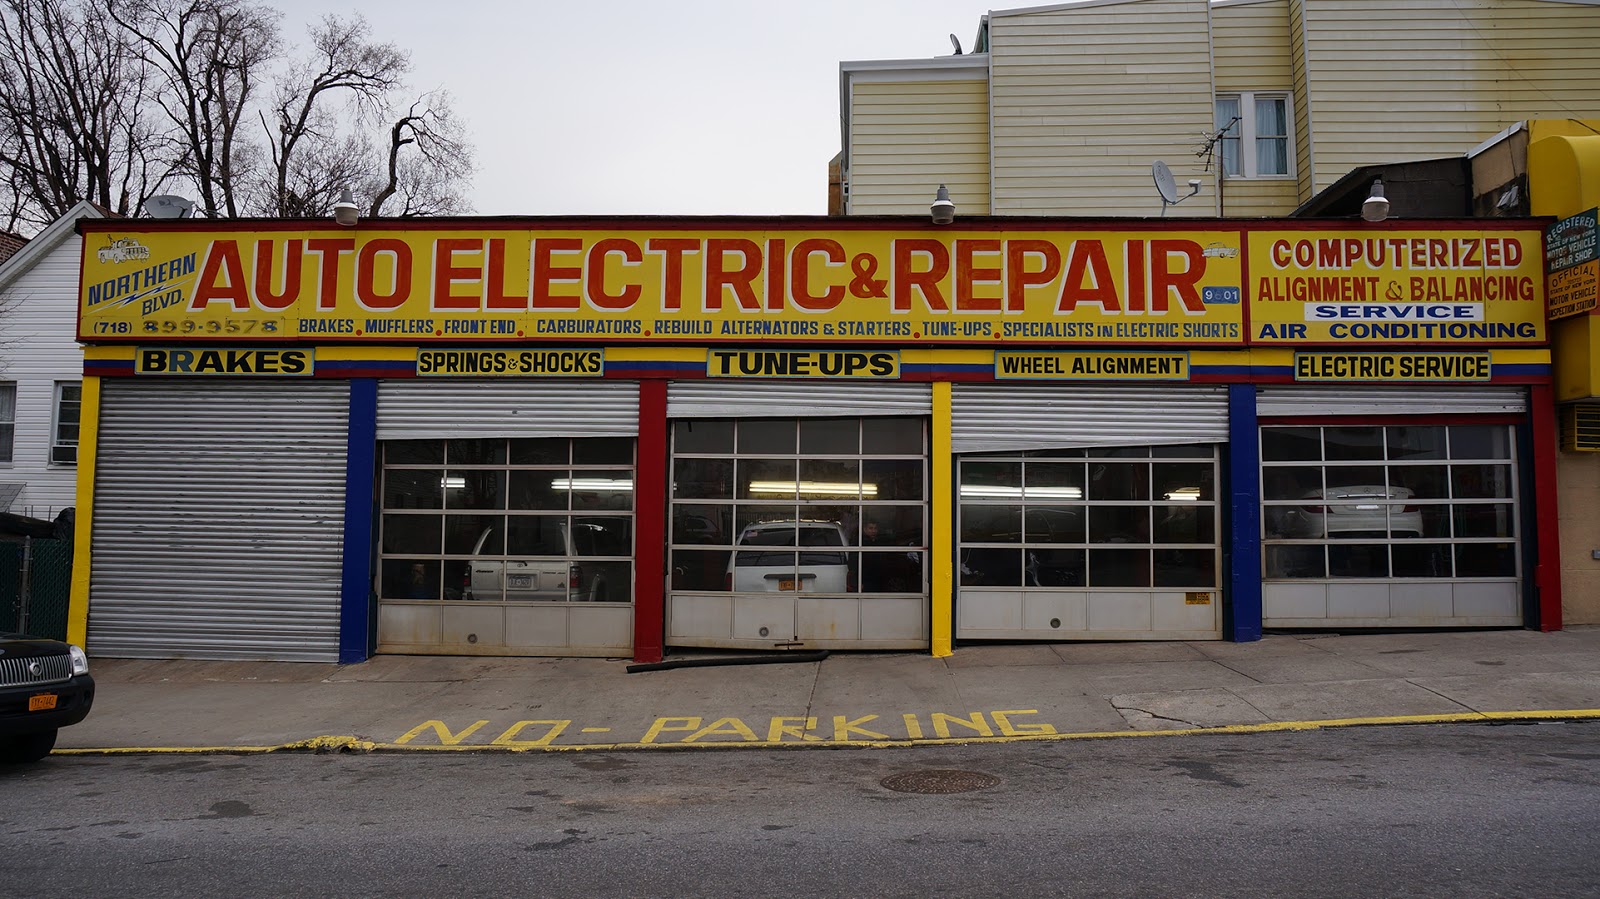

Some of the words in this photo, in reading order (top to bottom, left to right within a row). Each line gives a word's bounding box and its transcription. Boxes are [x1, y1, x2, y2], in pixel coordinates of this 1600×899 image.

[1546, 216, 1596, 243] REGISTERED
[1547, 240, 1561, 250] STATE
[1569, 234, 1581, 242] NEW
[1582, 228, 1596, 237] YORK
[1269, 238, 1523, 270] COMPUTERIZED
[1546, 246, 1569, 260] MOTOR
[1568, 235, 1597, 254] VEHICLE
[1550, 254, 1574, 270] REPAIR
[1574, 248, 1593, 262] SHOP
[87, 252, 196, 307] NORTHERN
[186, 238, 413, 313] AUTO
[429, 238, 846, 313] ELECTRIC
[849, 252, 888, 299] &
[890, 238, 1207, 316] REPAIR
[1551, 265, 1595, 288] OFFICIAL
[1258, 276, 1380, 302] ALIGNMENT
[1385, 280, 1404, 301] &
[1409, 276, 1535, 301] BALANCING
[1549, 293, 1569, 306] MOTOR
[1570, 286, 1597, 301] VEHICLE
[1550, 287, 1563, 295] STATE
[141, 288, 185, 317] BLVD.
[1314, 305, 1475, 318] SERVICE
[1550, 303, 1575, 318] INSPECTION
[1575, 297, 1597, 311] STATION
[93, 321, 134, 334] (718)
[299, 319, 354, 333] BRAKES
[365, 319, 434, 333] MUFFLERS
[444, 319, 486, 334] FRONT
[490, 319, 516, 334] END
[537, 319, 642, 334] CARBURATORS
[654, 319, 713, 334] REBUILD
[721, 320, 819, 335] ALTERNATORS
[823, 323, 835, 335] &
[838, 321, 911, 335] STARTERS
[922, 321, 992, 336] TUNE-UPS
[1003, 322, 1094, 337] SPECIALISTS
[1097, 325, 1113, 337] IN
[1116, 322, 1179, 338] ELECTRIC
[1182, 322, 1239, 338] SHORTS
[1259, 324, 1307, 339] AIR
[1329, 322, 1536, 339] CONDITIONING
[142, 350, 305, 373] BRAKES
[419, 352, 507, 373] SPRINGS
[519, 352, 601, 373] SHOCKS
[714, 352, 894, 376] TUNE-UPS
[1002, 356, 1065, 374] WHEEL
[1072, 356, 1184, 375] ALIGNMENT
[1298, 356, 1395, 377] ELECTRIC
[1399, 356, 1488, 378] SERVICE
[639, 709, 1057, 744] PARKING
